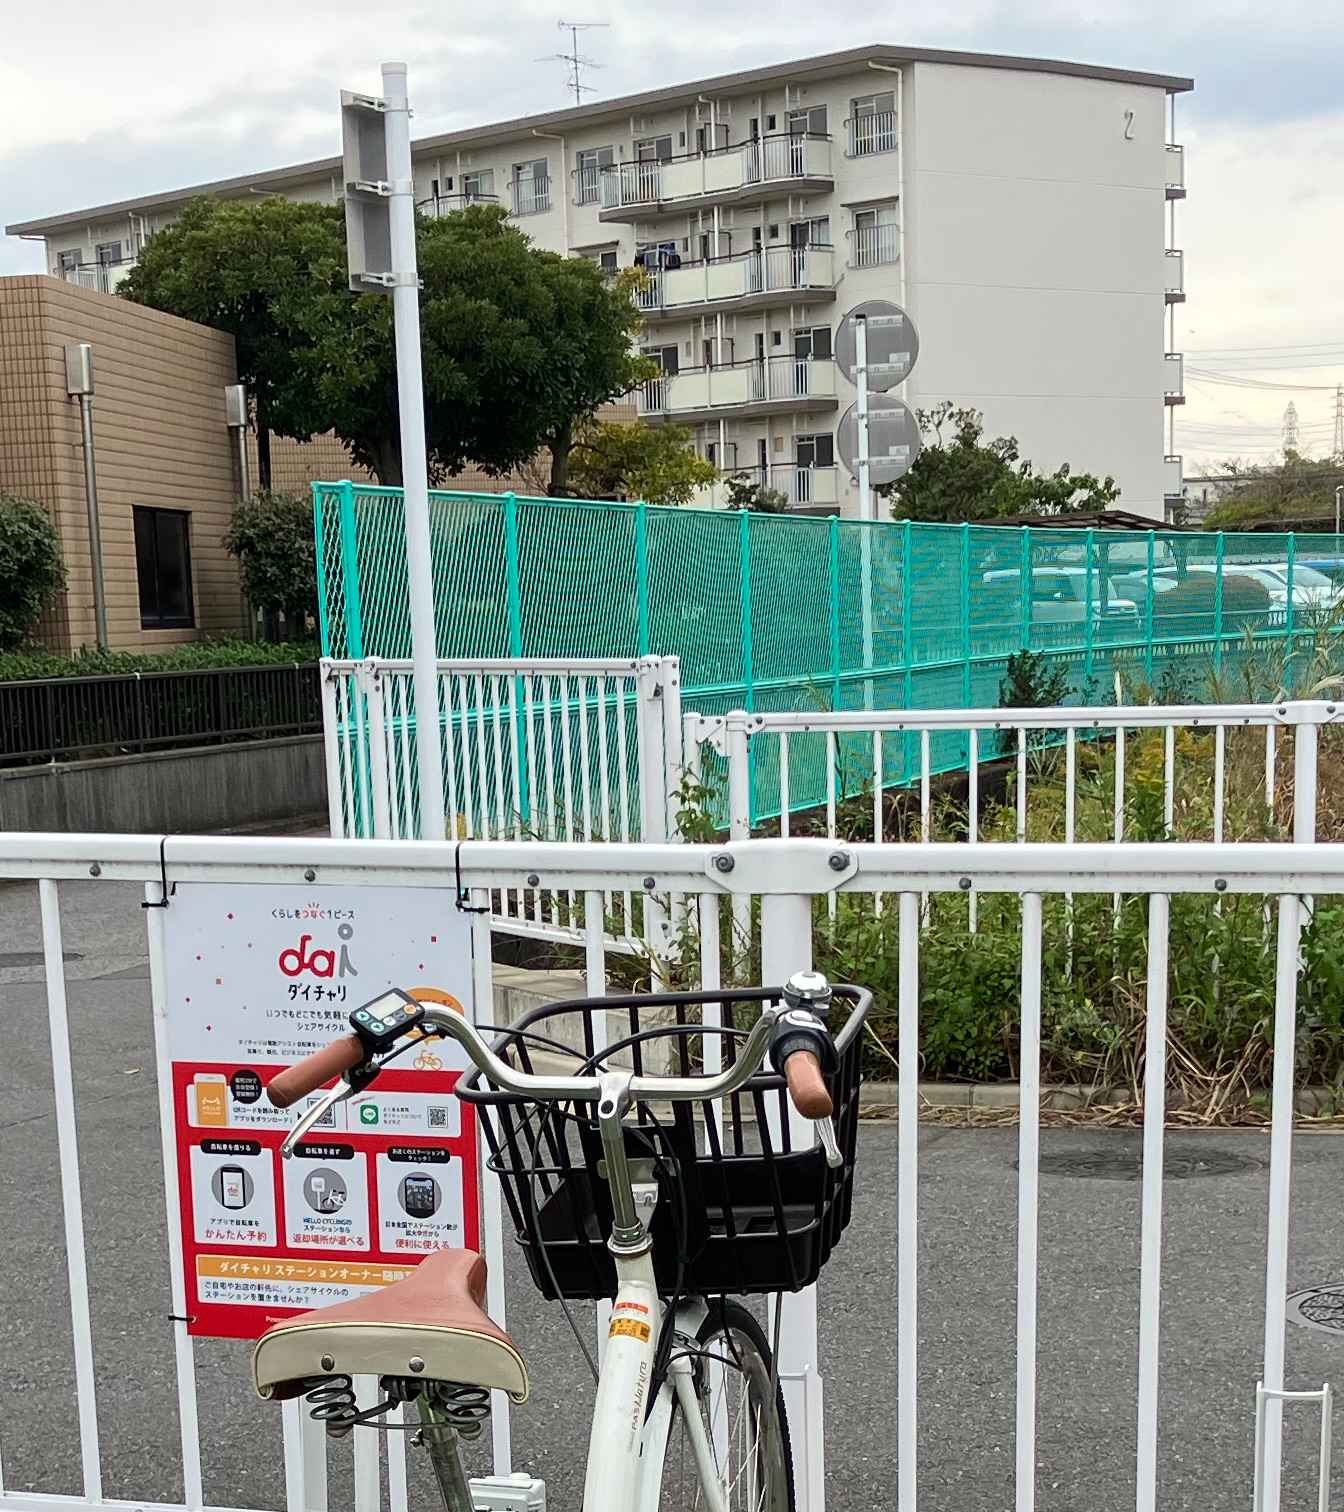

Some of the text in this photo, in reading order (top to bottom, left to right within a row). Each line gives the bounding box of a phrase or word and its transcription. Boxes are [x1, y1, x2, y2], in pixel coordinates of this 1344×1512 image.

[279, 923, 358, 978] dai
[288, 983, 347, 1001] ダイチャリ
[296, 1023, 346, 1032] シェアサイクル
[206, 1229, 268, 1242] かんたん予約
[292, 1233, 365, 1247] 返却場所が選べる
[395, 1238, 450, 1250] 便利に使える
[219, 1261, 272, 1274] ダイチャリ
